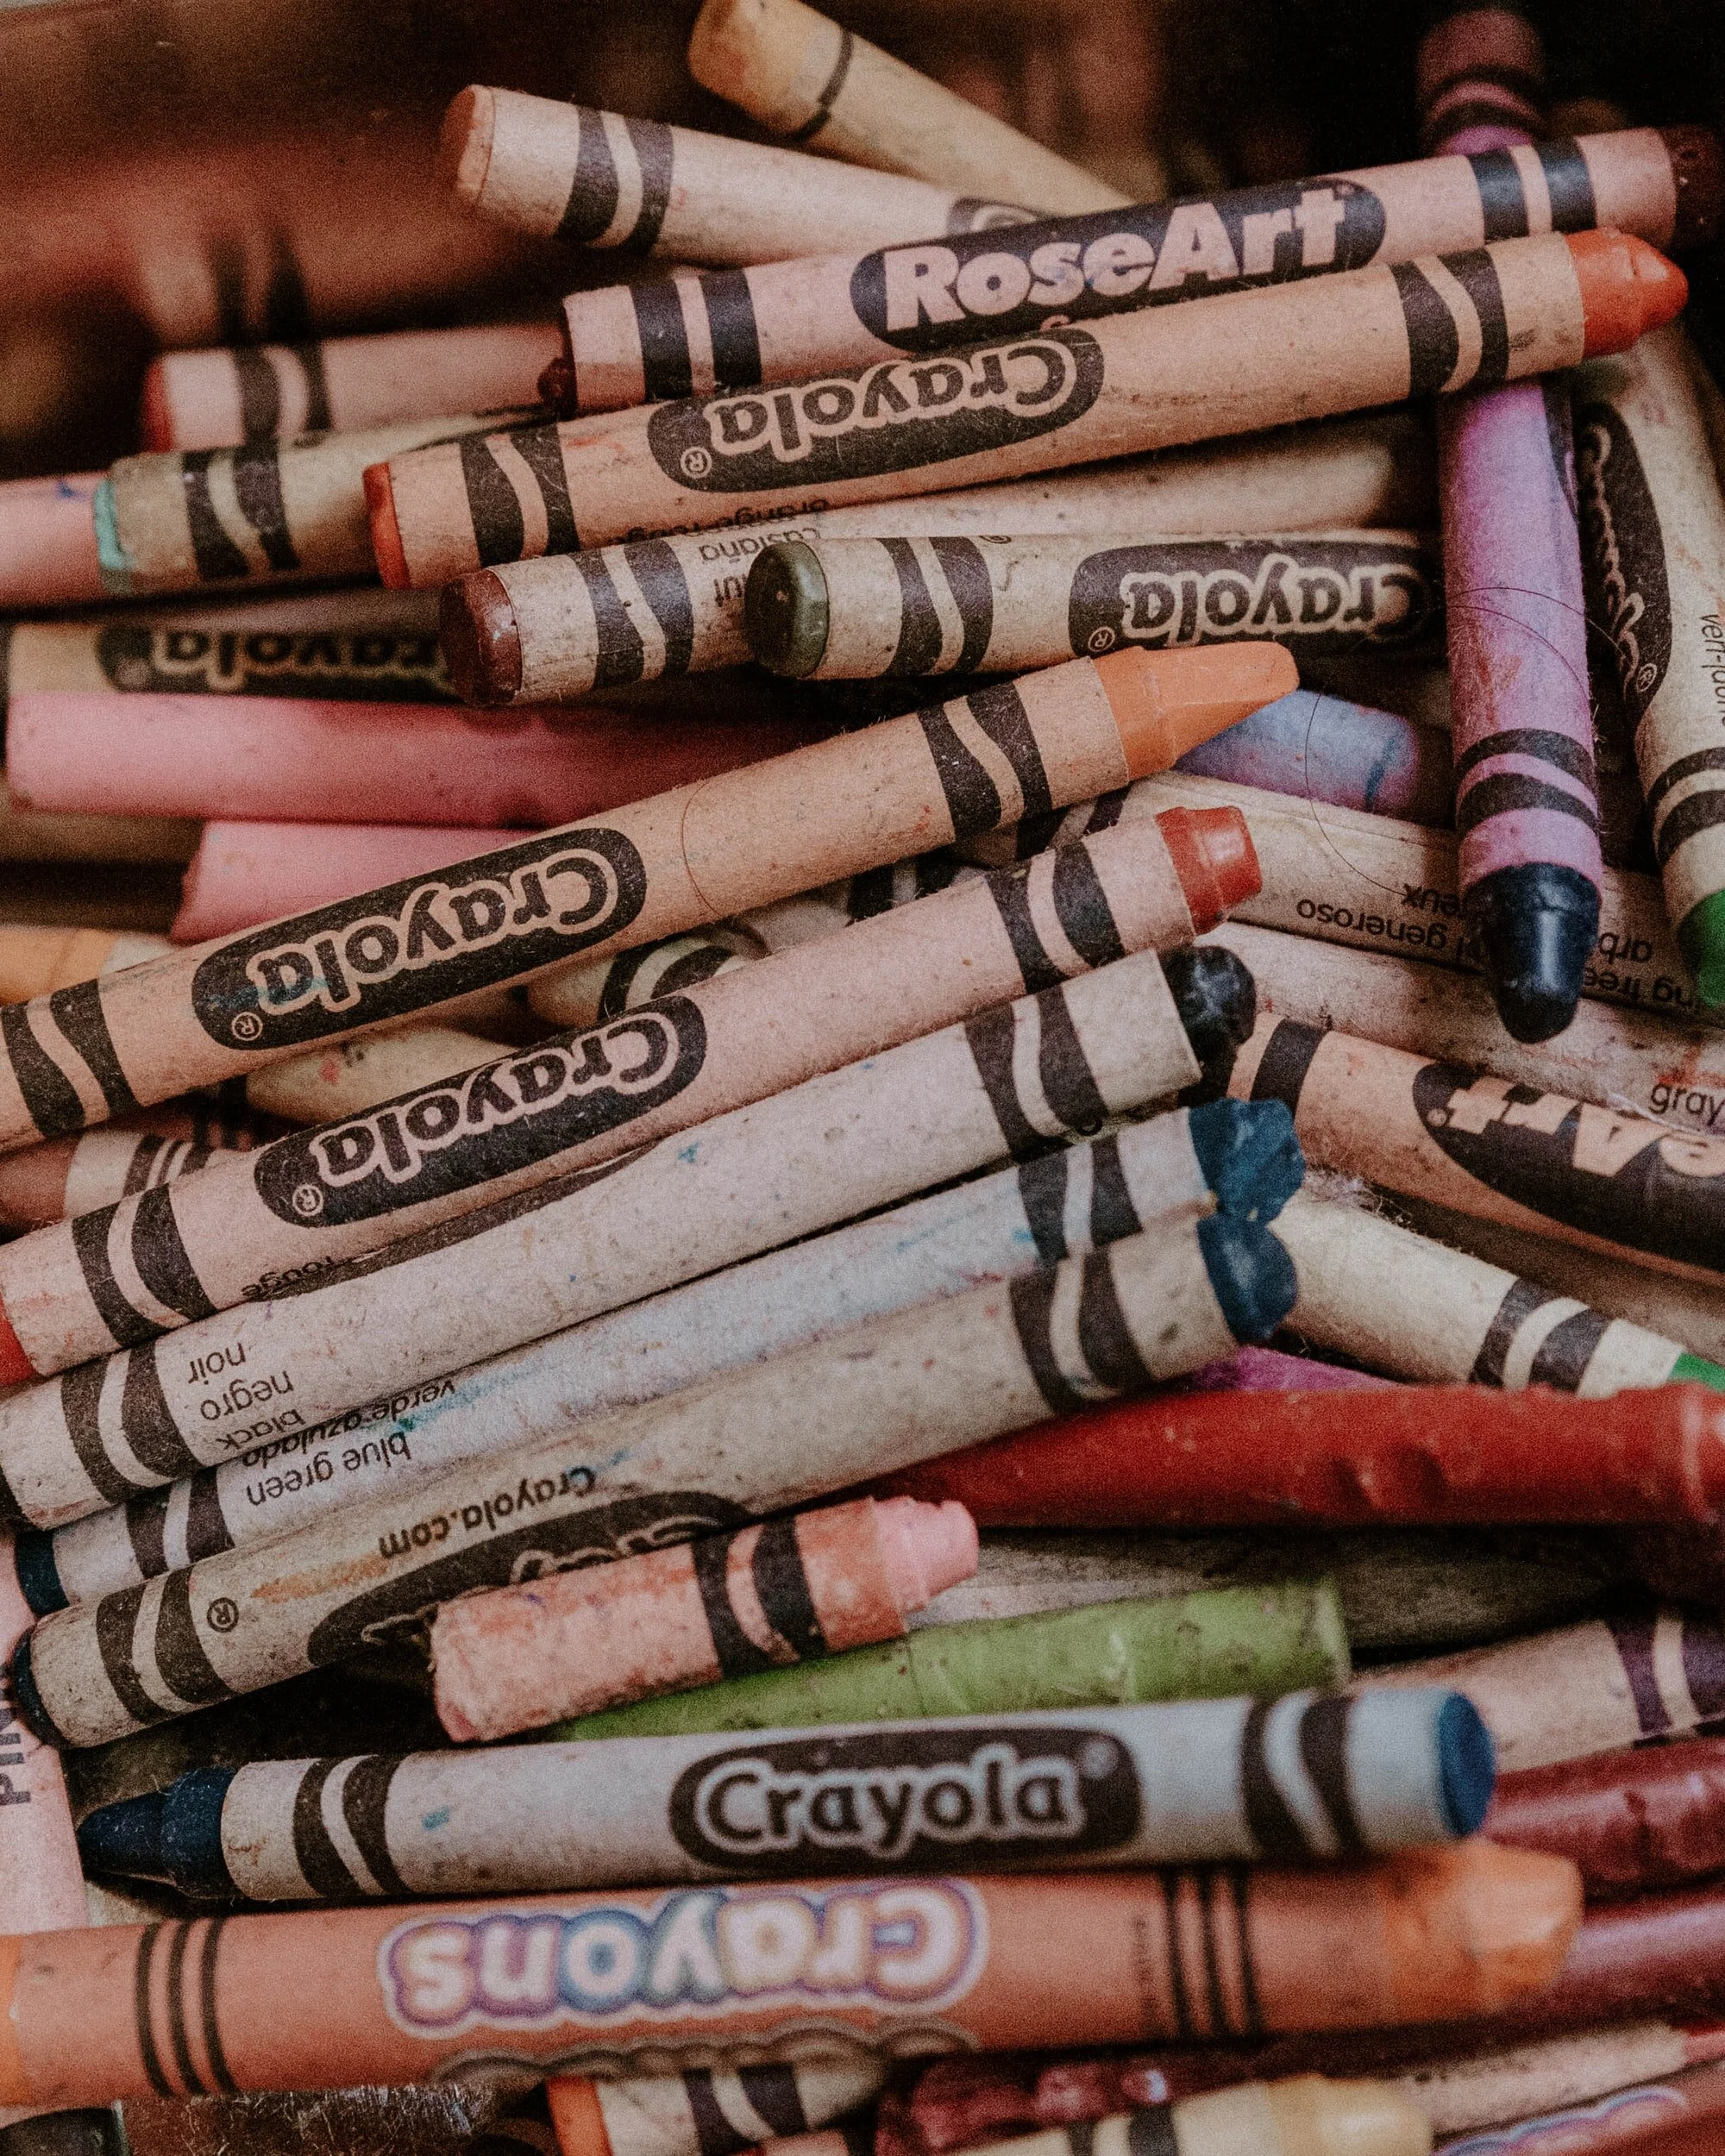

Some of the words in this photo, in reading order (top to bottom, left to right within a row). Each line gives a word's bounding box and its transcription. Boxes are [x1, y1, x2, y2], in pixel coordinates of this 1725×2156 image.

[885, 186, 1346, 334] RoseArt
[703, 339, 1078, 463] Crayola
[1120, 553, 1427, 647] Crayola
[248, 848, 620, 1012] Crayola
[1296, 900, 1448, 951] generoso
[310, 1010, 681, 1182] Crayola
[1648, 1083, 1725, 1125] gray
[188, 1342, 246, 1385] noir
[200, 1371, 294, 1420] negro
[216, 1409, 306, 1451] black
[376, 1380, 456, 1422] verde
[242, 1405, 362, 1469] azulado
[342, 1432, 412, 1472] blue
[247, 1451, 334, 1506] green
[378, 1466, 598, 1559] Crayola.com
[696, 1745, 1083, 1860] Crayola
[379, 1879, 988, 2039] Crayons
